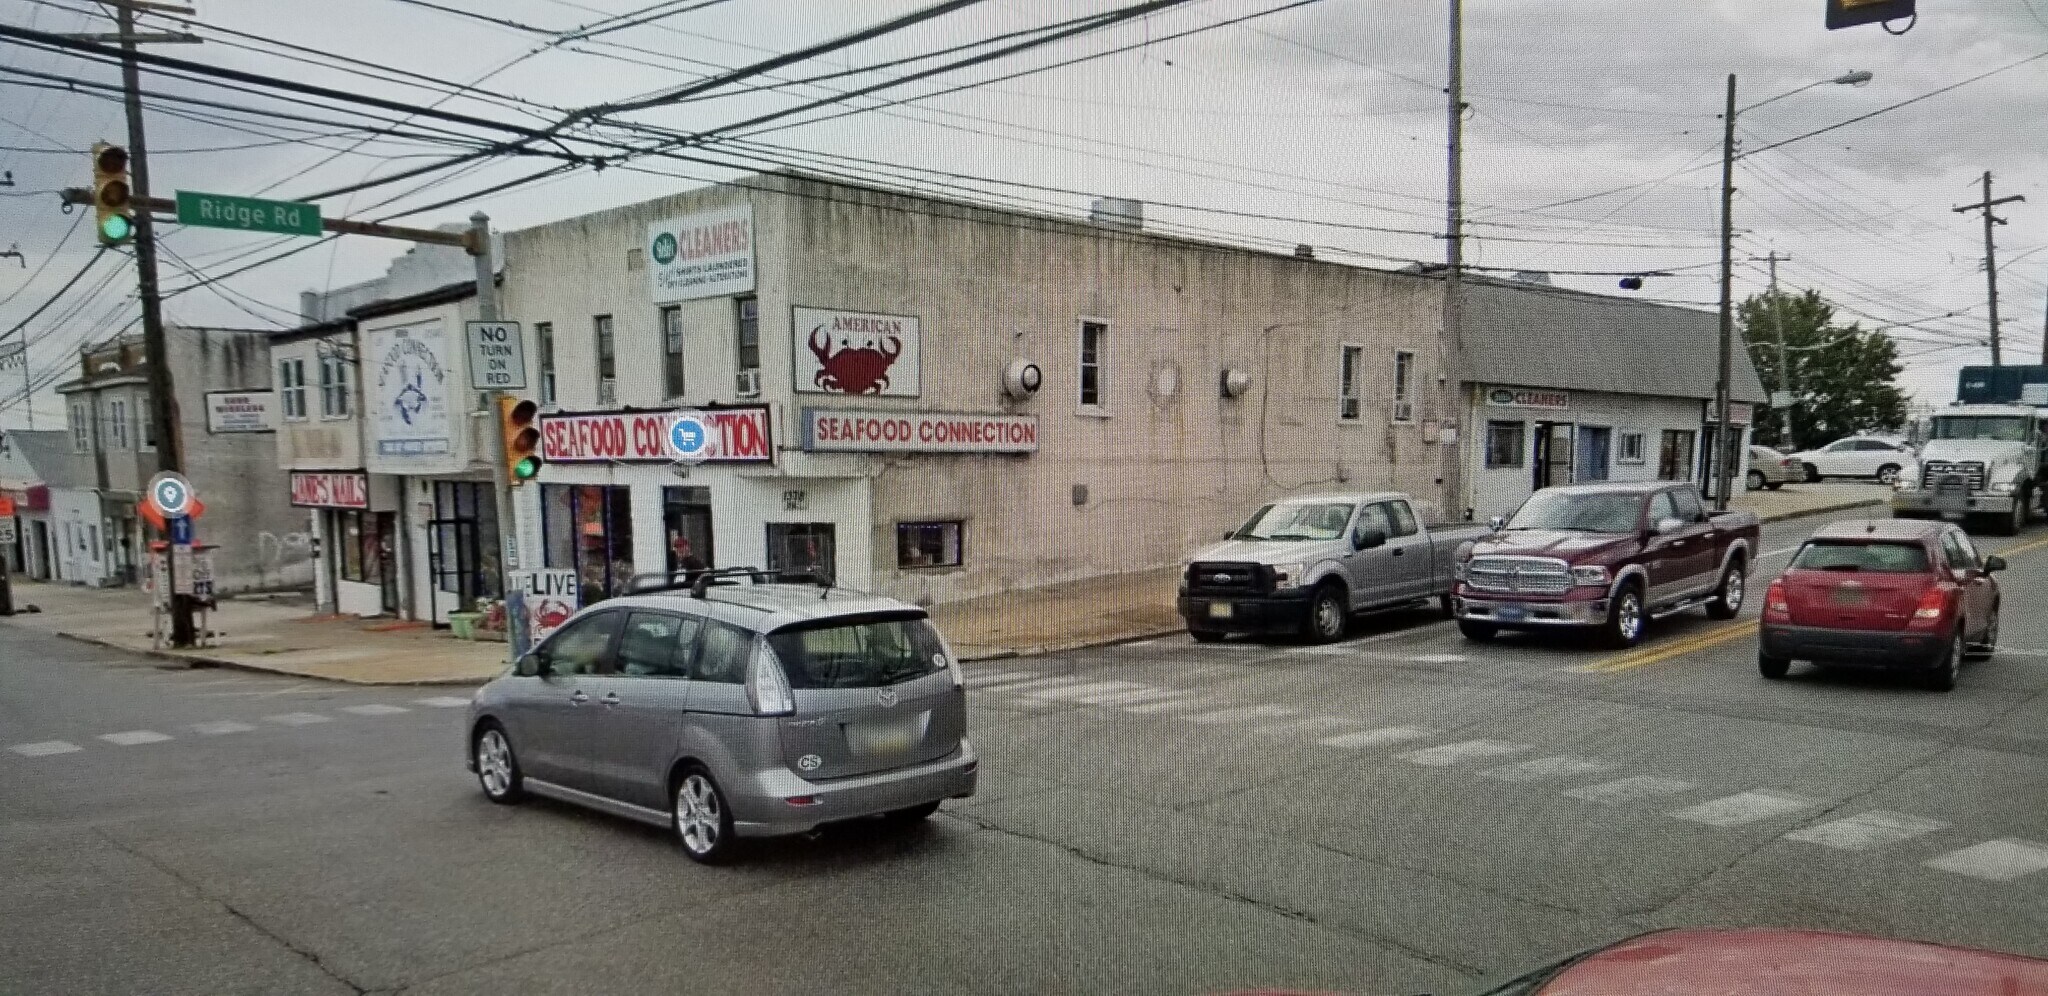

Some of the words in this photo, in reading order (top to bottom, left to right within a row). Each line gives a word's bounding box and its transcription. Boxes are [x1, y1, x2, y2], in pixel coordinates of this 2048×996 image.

[200, 199, 265, 227] Ridge
[274, 205, 301, 228] Rd
[679, 218, 749, 261] CLEANERS
[832, 316, 902, 334] AMERICAN
[481, 327, 508, 342] NO
[480, 344, 512, 357] TURN
[487, 359, 506, 371] ON
[486, 372, 511, 384] RED
[1515, 391, 1568, 406] CLEANERS
[545, 418, 627, 457] SEAFOOD
[817, 416, 912, 442] SEAFOOD
[918, 420, 1036, 444] CONNECTION
[532, 572, 576, 596] LIVE
[800, 756, 819, 768] CS
